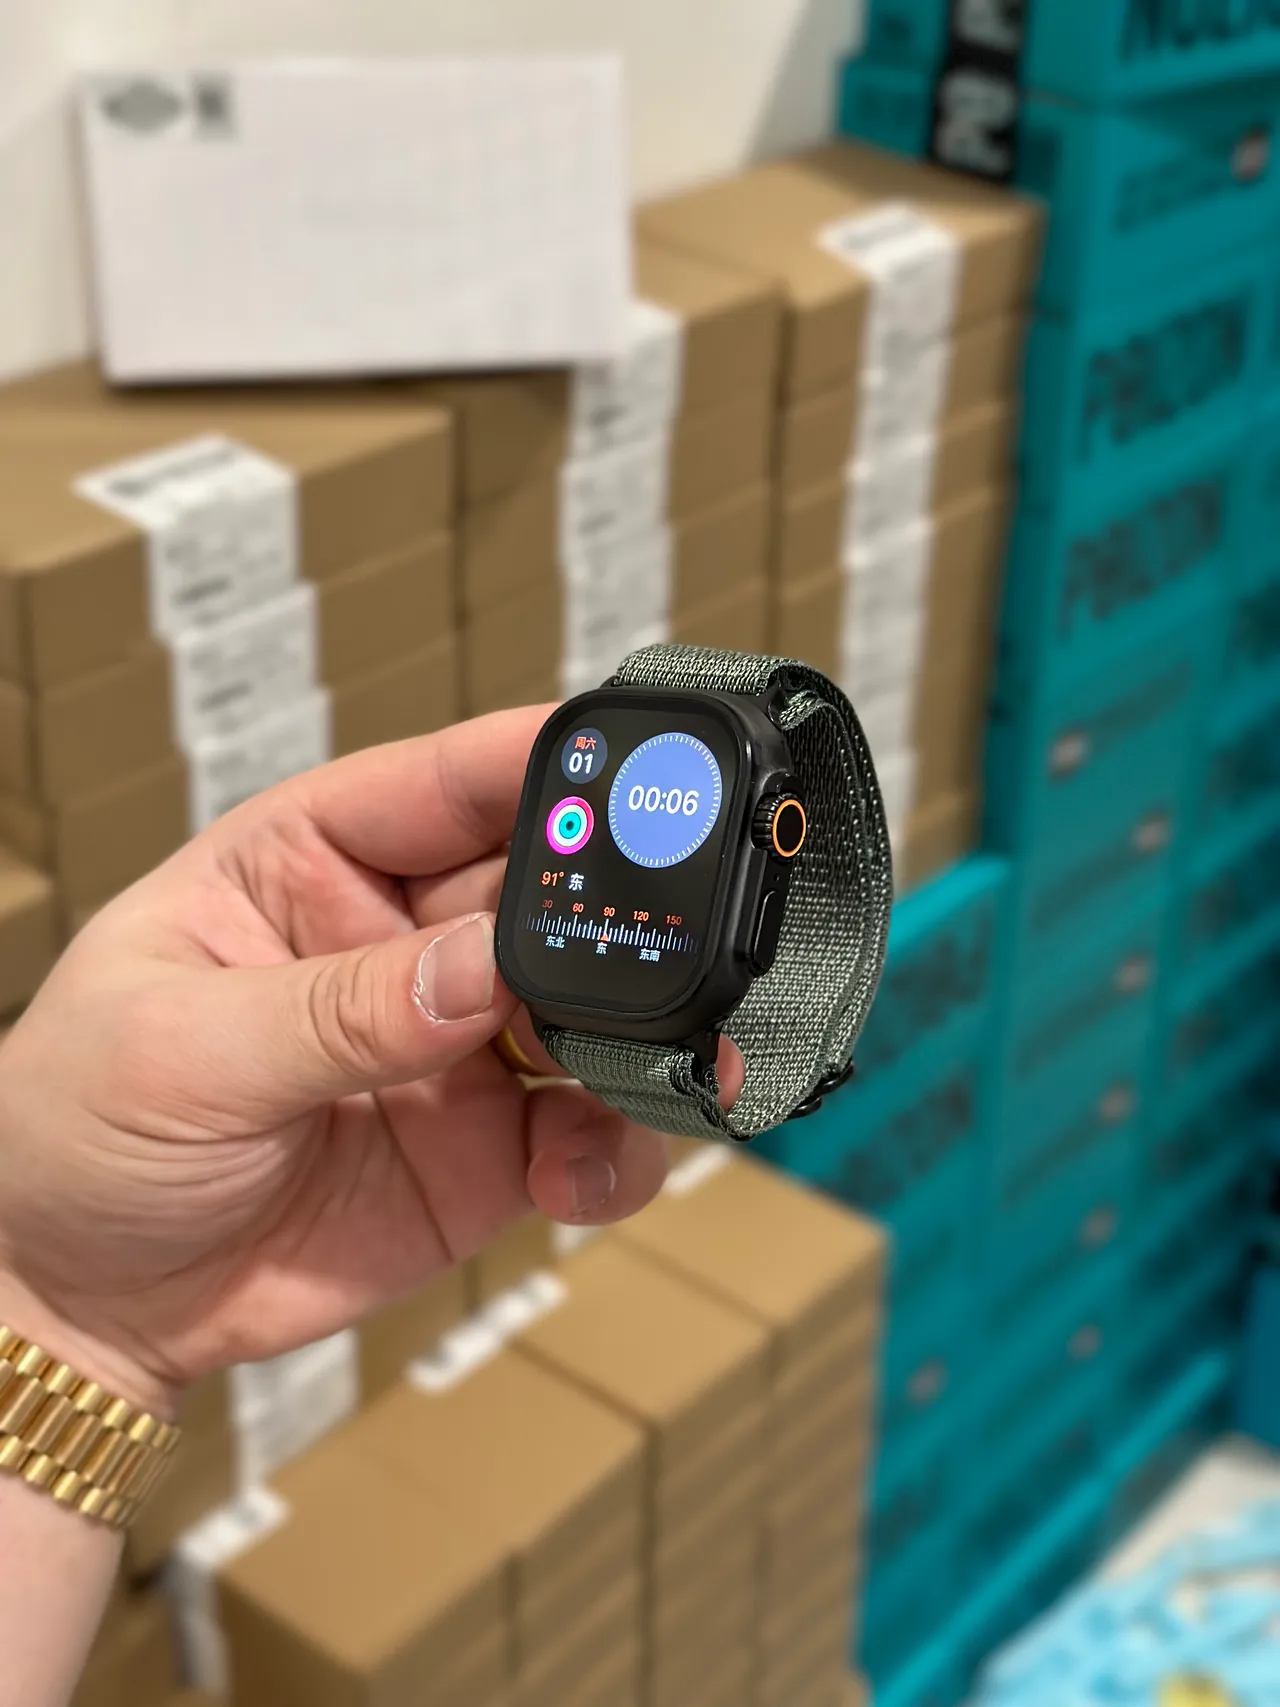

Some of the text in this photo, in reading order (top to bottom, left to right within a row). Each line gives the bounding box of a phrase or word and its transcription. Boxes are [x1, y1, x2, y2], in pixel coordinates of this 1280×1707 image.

[575, 736, 596, 750] 周六
[569, 752, 594, 774] 01
[628, 785, 699, 816] 00:06
[541, 871, 584, 891] 91° 东
[542, 900, 682, 925] 30 60 90 120 150
[545, 935, 661, 962] 东北 东 东南
